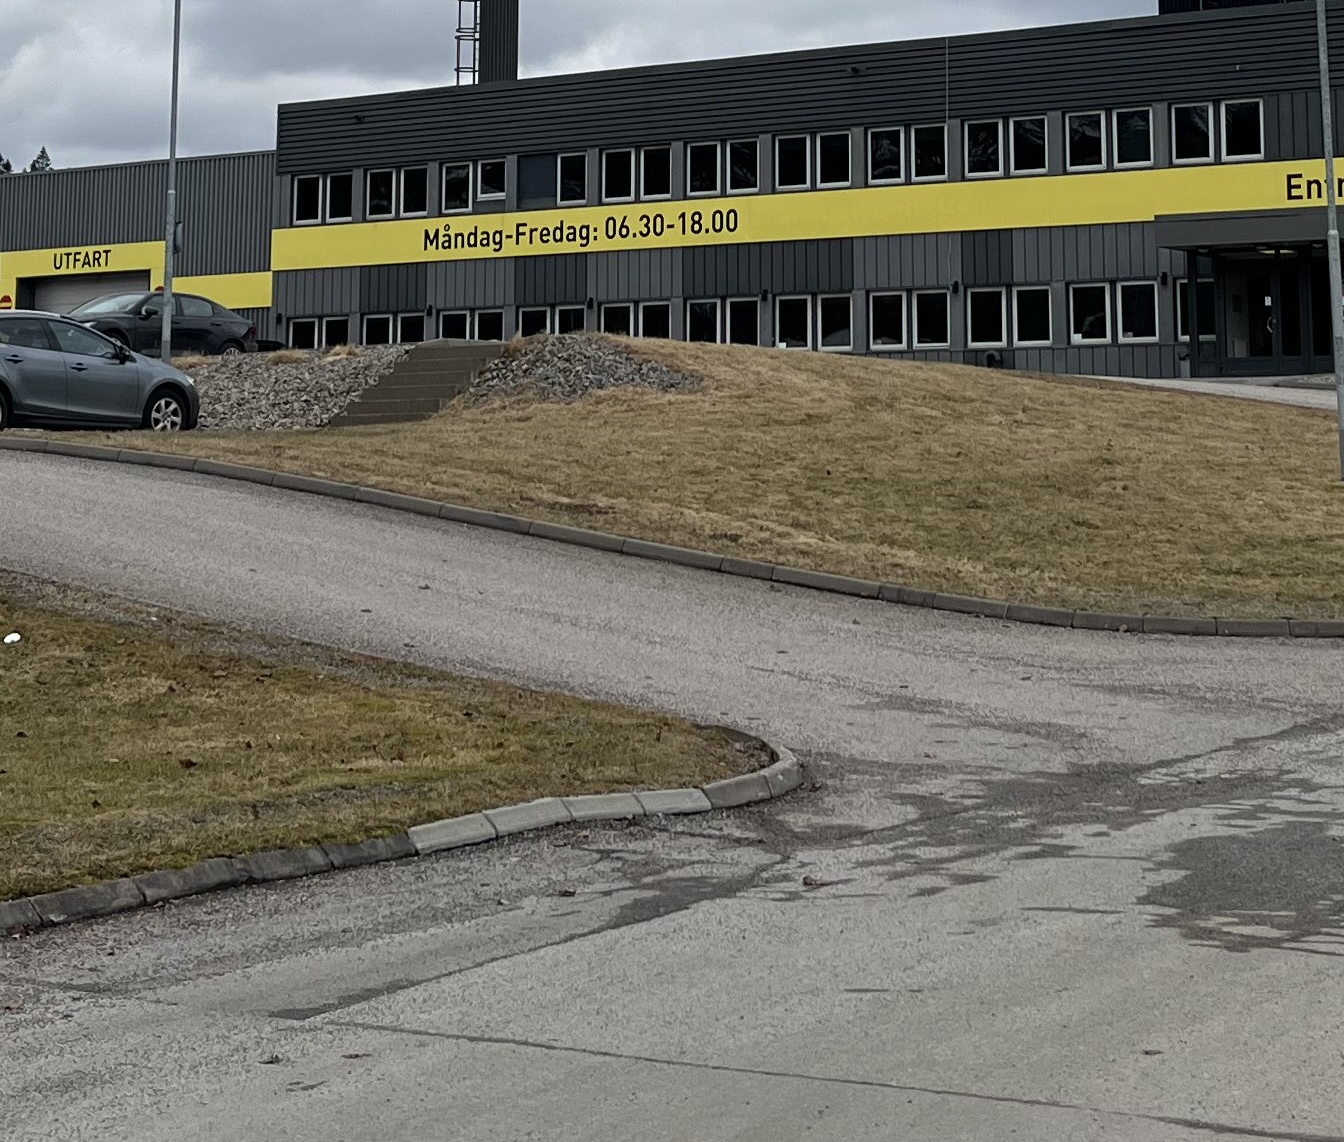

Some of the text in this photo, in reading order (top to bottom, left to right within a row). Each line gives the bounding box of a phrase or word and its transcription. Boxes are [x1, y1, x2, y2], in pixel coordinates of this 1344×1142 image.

[423, 208, 738, 253] Måndag-Fredag: 06.30-18.00
[53, 249, 112, 270] UTFART
